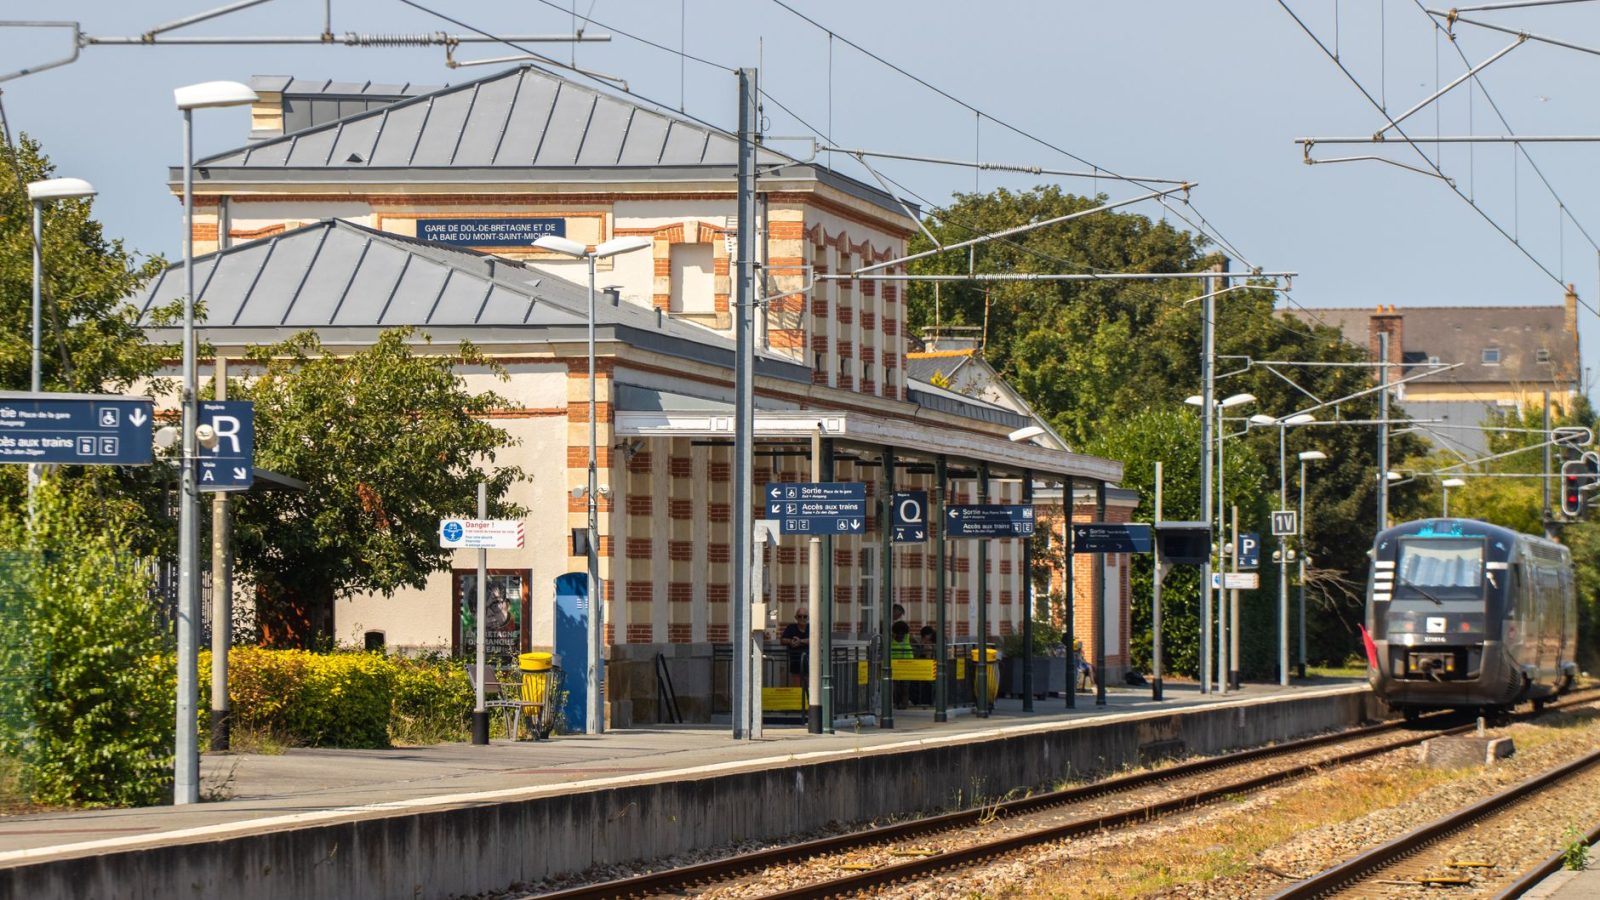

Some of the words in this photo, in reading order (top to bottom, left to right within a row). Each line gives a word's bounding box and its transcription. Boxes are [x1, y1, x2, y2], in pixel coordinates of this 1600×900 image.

[425, 224, 446, 232] GARE
[448, 224, 458, 232] DE
[427, 233, 438, 241] LA
[212, 415, 241, 452] R
[18, 439, 39, 447] aux
[42, 436, 74, 447] trains
[82, 443, 91, 453] B
[104, 444, 113, 453] C
[203, 469, 214, 481] A
[900, 499, 922, 522] Q
[465, 521, 490, 529] Danger
[1276, 515, 1292, 531] 1V
[896, 532, 904, 540] A
[1243, 539, 1255, 554] P
